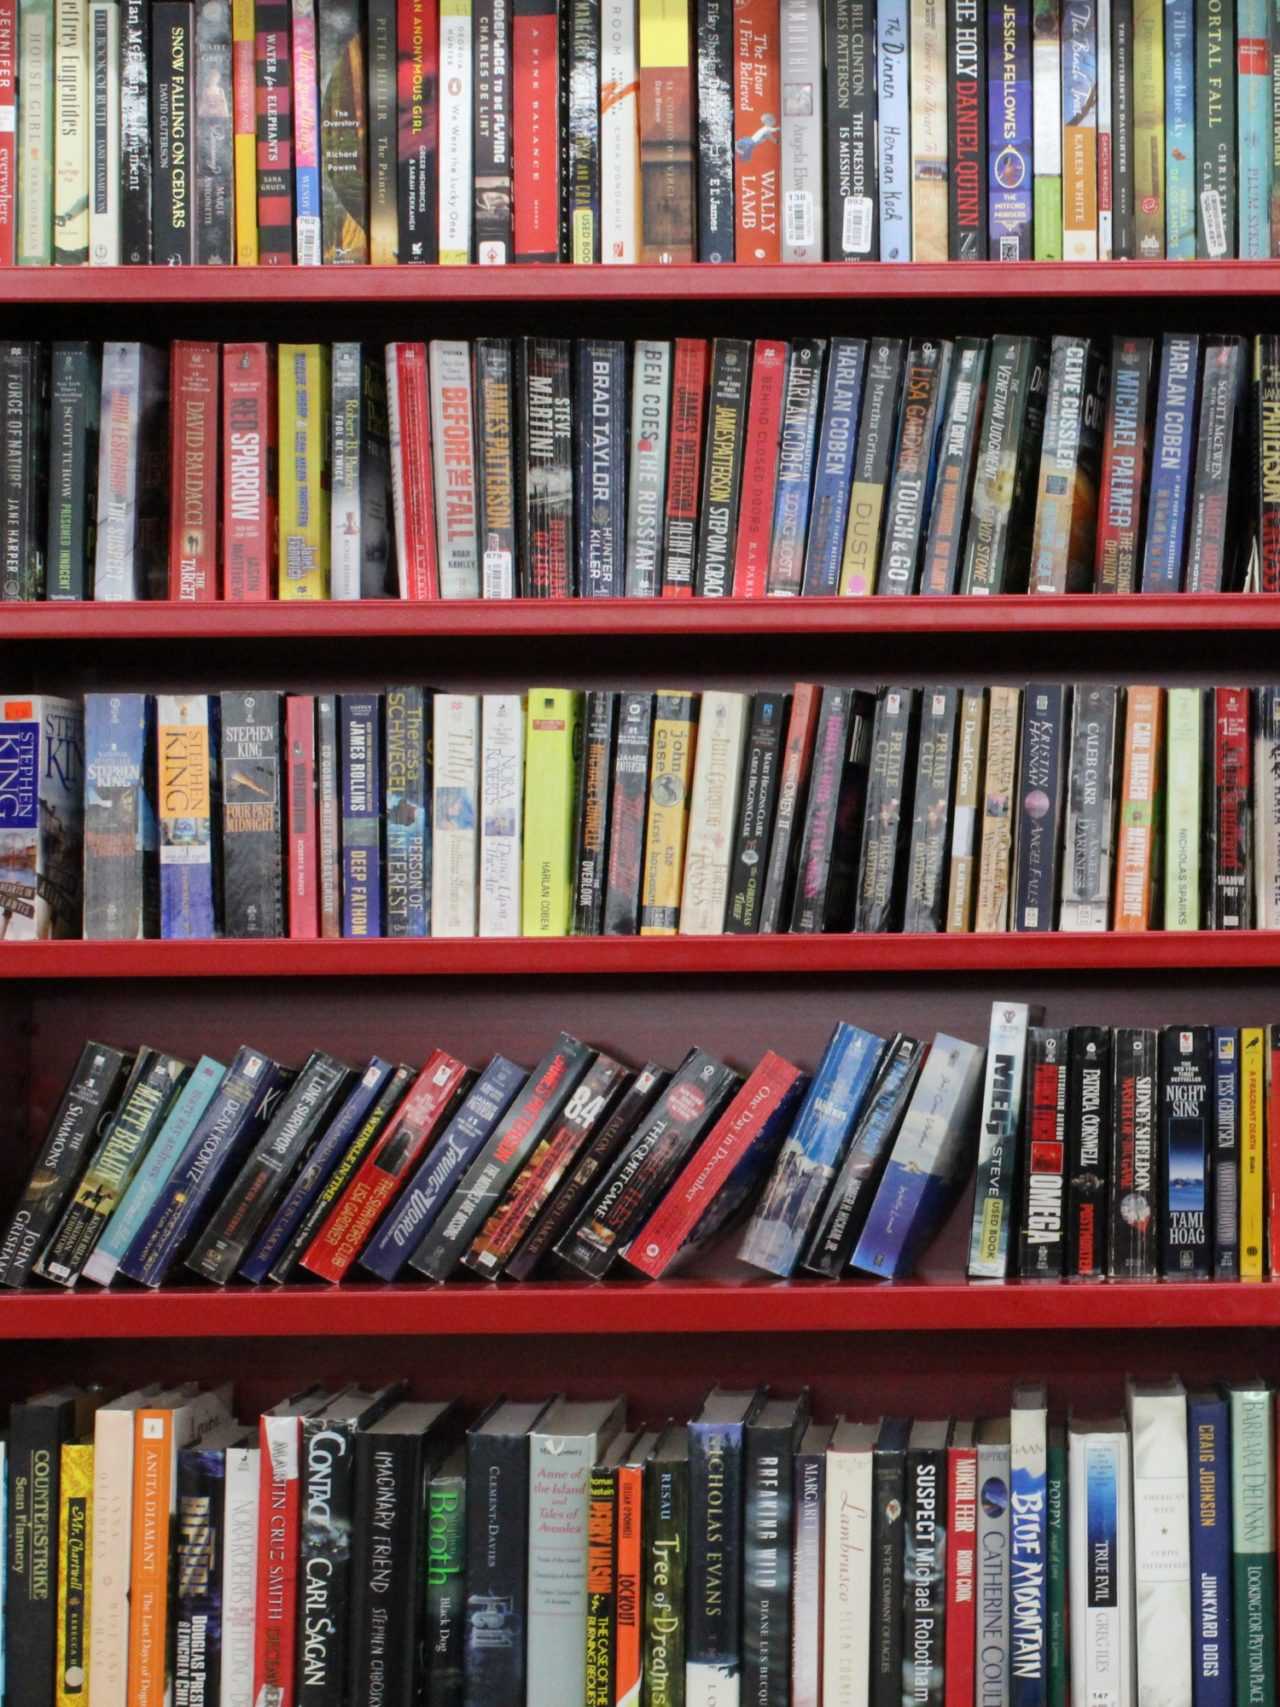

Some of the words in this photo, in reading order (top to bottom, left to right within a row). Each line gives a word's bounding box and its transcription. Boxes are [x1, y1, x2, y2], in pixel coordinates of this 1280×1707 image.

[171, 27, 185, 72] SNOW
[884, 18, 900, 36] The
[956, 28, 977, 78] HOLY
[1004, 4, 1015, 61] JESSICA
[882, 43, 904, 98] Dinner
[172, 76, 185, 139] FALLING
[955, 81, 978, 159] DANIEL
[1004, 64, 1015, 139] FELLOWES
[172, 142, 185, 165] ON
[884, 126, 900, 184] Herman
[172, 168, 185, 228] CEDARS
[742, 175, 755, 228] LAMB
[760, 170, 775, 234] WALLY
[884, 192, 902, 221] Koch
[955, 161, 978, 225] QUINN
[593, 361, 609, 416] BRAD
[1166, 340, 1189, 405] HARLAN
[230, 399, 258, 431] RED
[442, 388, 470, 466] BEFORE
[1113, 370, 1140, 448] MICHAEL
[593, 423, 609, 500] TAYLOR
[1161, 412, 1183, 468] COBEN
[231, 433, 260, 520] SPARROW
[1109, 456, 1134, 527] PALMER
[447, 490, 474, 542] FALL
[893, 479, 921, 538] TOUCH
[590, 530, 600, 579] KILLER
[602, 527, 613, 582] HUNTER
[850, 503, 872, 570] DUST
[892, 541, 907, 551] &
[888, 555, 911, 580] GO
[350, 721, 365, 760] JAMES
[1028, 720, 1040, 786] HANNAH
[1038, 720, 1053, 787] KRISTIN
[165, 732, 188, 811] KING
[189, 731, 204, 811] STEPHEN
[351, 764, 365, 811] ROLLINS
[351, 851, 367, 881] DEEP
[388, 831, 407, 917] INTEREST
[408, 837, 423, 888] PERSON
[351, 887, 367, 934] FATHOM
[409, 893, 423, 910] OF
[300, 1076, 328, 1105] LONE
[749, 1085, 770, 1111] One
[986, 1054, 1015, 1136] MEG
[1166, 1085, 1206, 1102] NIGHT
[1172, 1102, 1200, 1117] SINS
[45, 1103, 83, 1169] SUMMONS
[70, 1132, 84, 1151] THE
[273, 1103, 315, 1154] SURVIVOR
[725, 1134, 740, 1144] in
[731, 1109, 753, 1133] Day
[684, 1145, 730, 1202] December
[989, 1146, 1003, 1196] STEVE
[990, 1201, 1001, 1226] USED
[1028, 1174, 1062, 1244] OMEGA
[1168, 1227, 1205, 1244] HOAG
[1169, 1212, 1204, 1228] TAMI
[987, 1228, 999, 1259] BOOK
[33, 1450, 50, 1600] COUNTERSTRIKE
[916, 1465, 935, 1541] SUSPECT
[1012, 1492, 1042, 1554] BLUE
[428, 1492, 459, 1585] Booth
[653, 1534, 679, 1584] Tree
[305, 1558, 332, 1612] CARL
[654, 1592, 668, 1612] of
[915, 1548, 934, 1612] Michael
[1200, 1573, 1218, 1638] JUNKYARD
[1011, 1560, 1043, 1678] MOUNTAIN
[304, 1618, 331, 1686] SAGAN
[652, 1617, 678, 1704] Dreams
[914, 1619, 932, 1701] Robotham
[1202, 1644, 1219, 1677] DOGS
